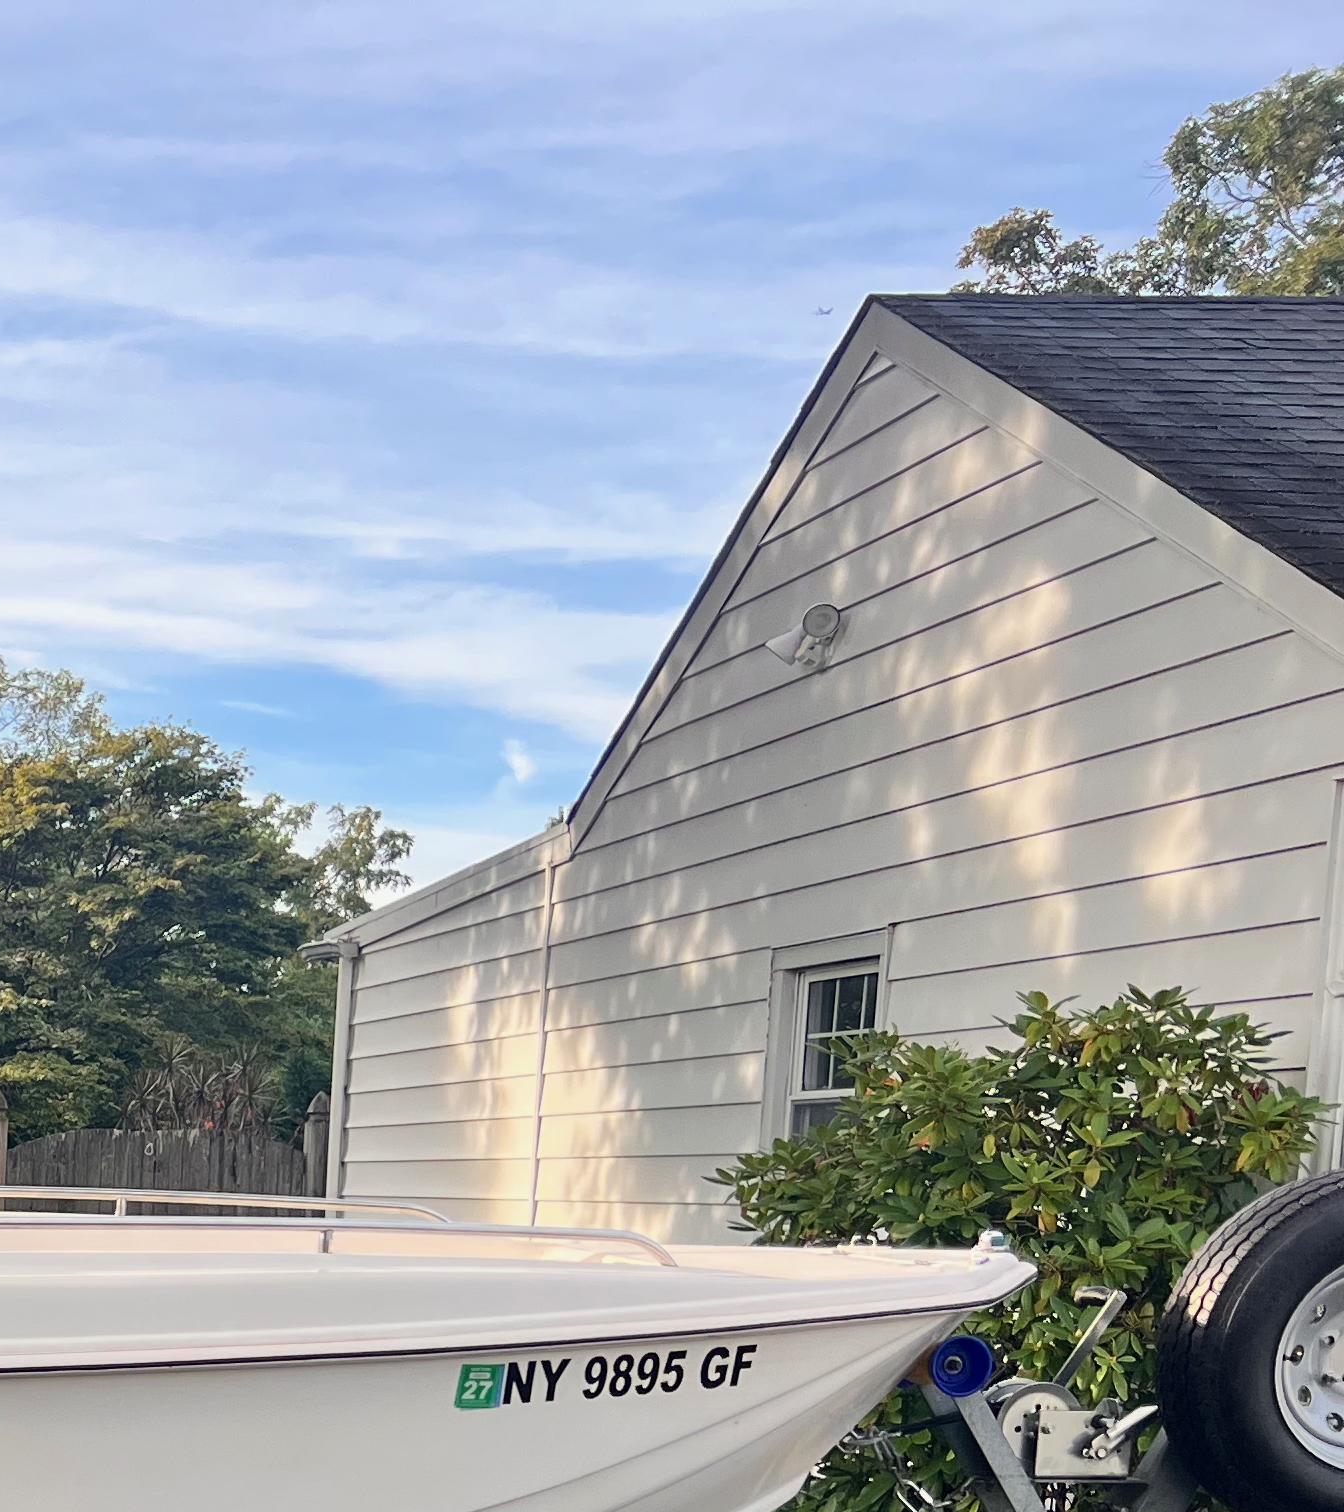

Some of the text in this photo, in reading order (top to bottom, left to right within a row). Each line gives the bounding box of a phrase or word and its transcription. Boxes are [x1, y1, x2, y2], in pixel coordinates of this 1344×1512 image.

[461, 1380, 494, 1400] 27
[502, 1344, 758, 1405] NY 9895 GF
